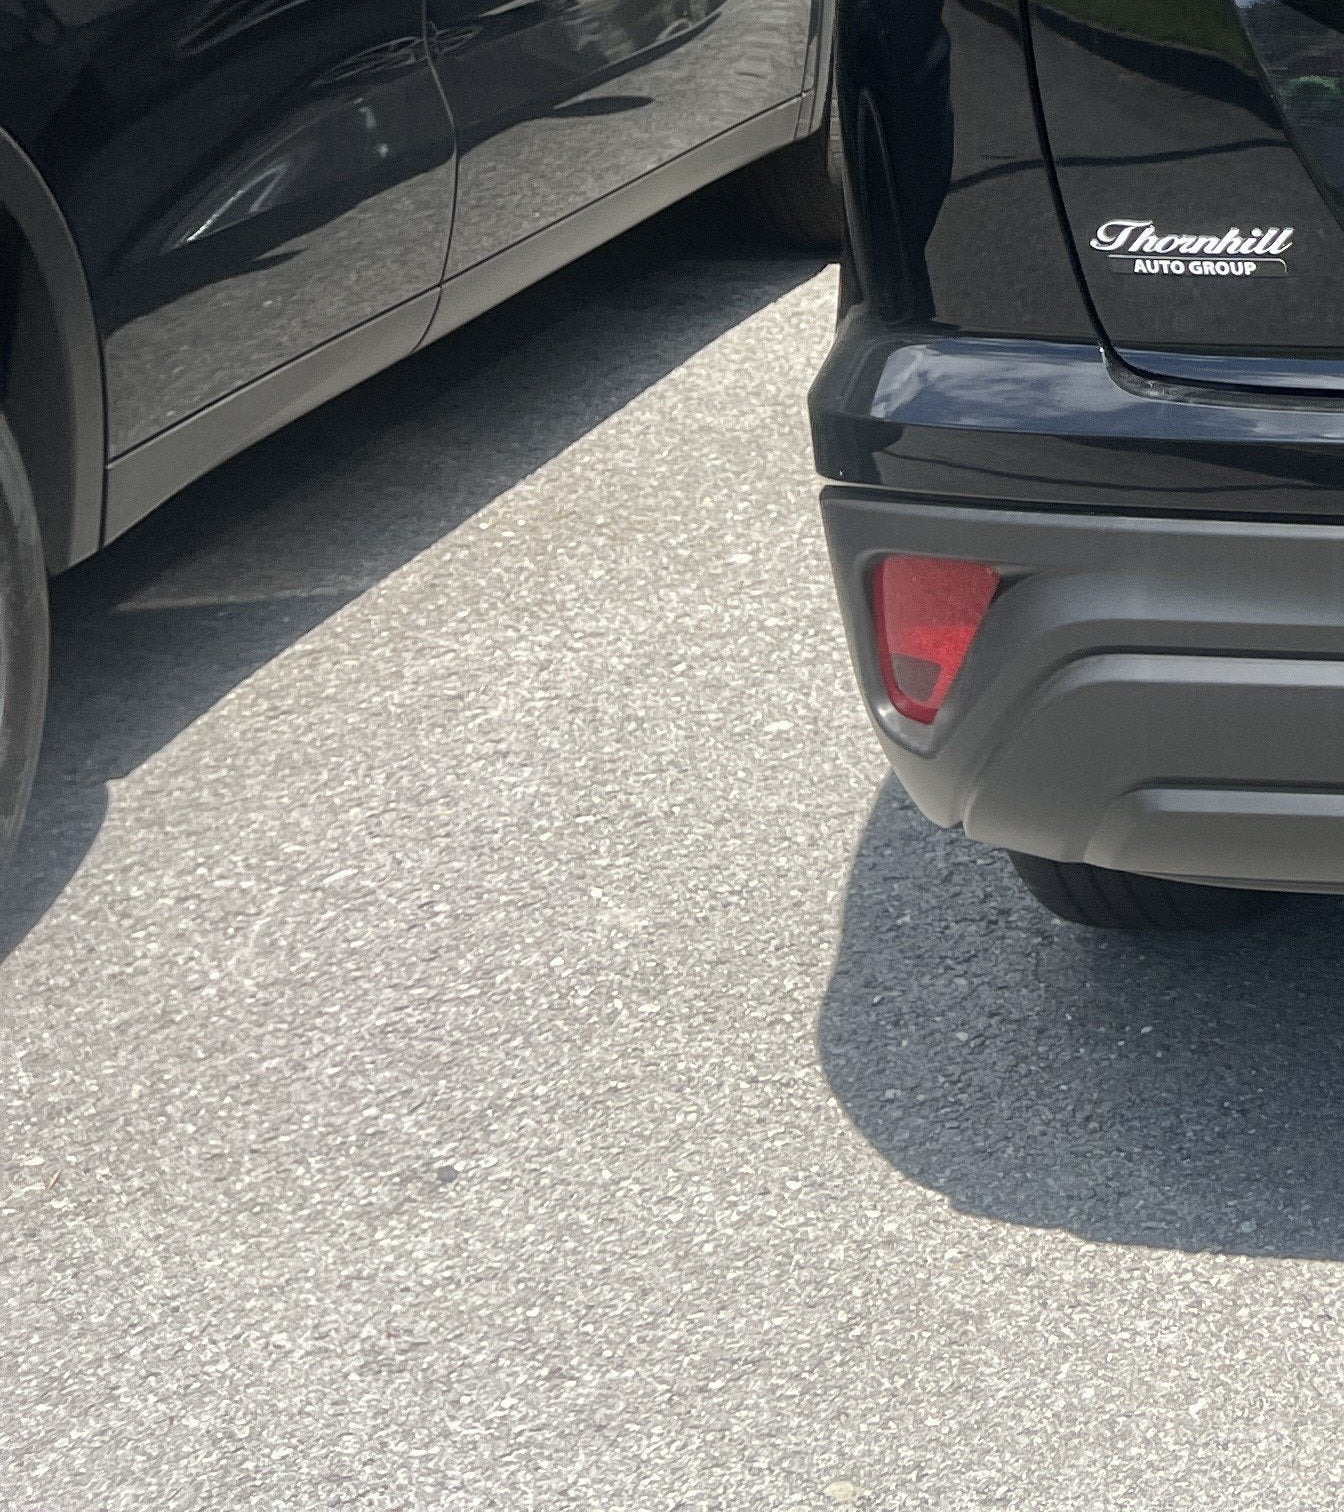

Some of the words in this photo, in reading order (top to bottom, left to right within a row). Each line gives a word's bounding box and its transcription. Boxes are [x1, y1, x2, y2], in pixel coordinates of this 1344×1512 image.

[1089, 218, 1294, 256] Thornhill
[1134, 260, 1185, 275] AUTO
[1189, 261, 1257, 276] GROUP
